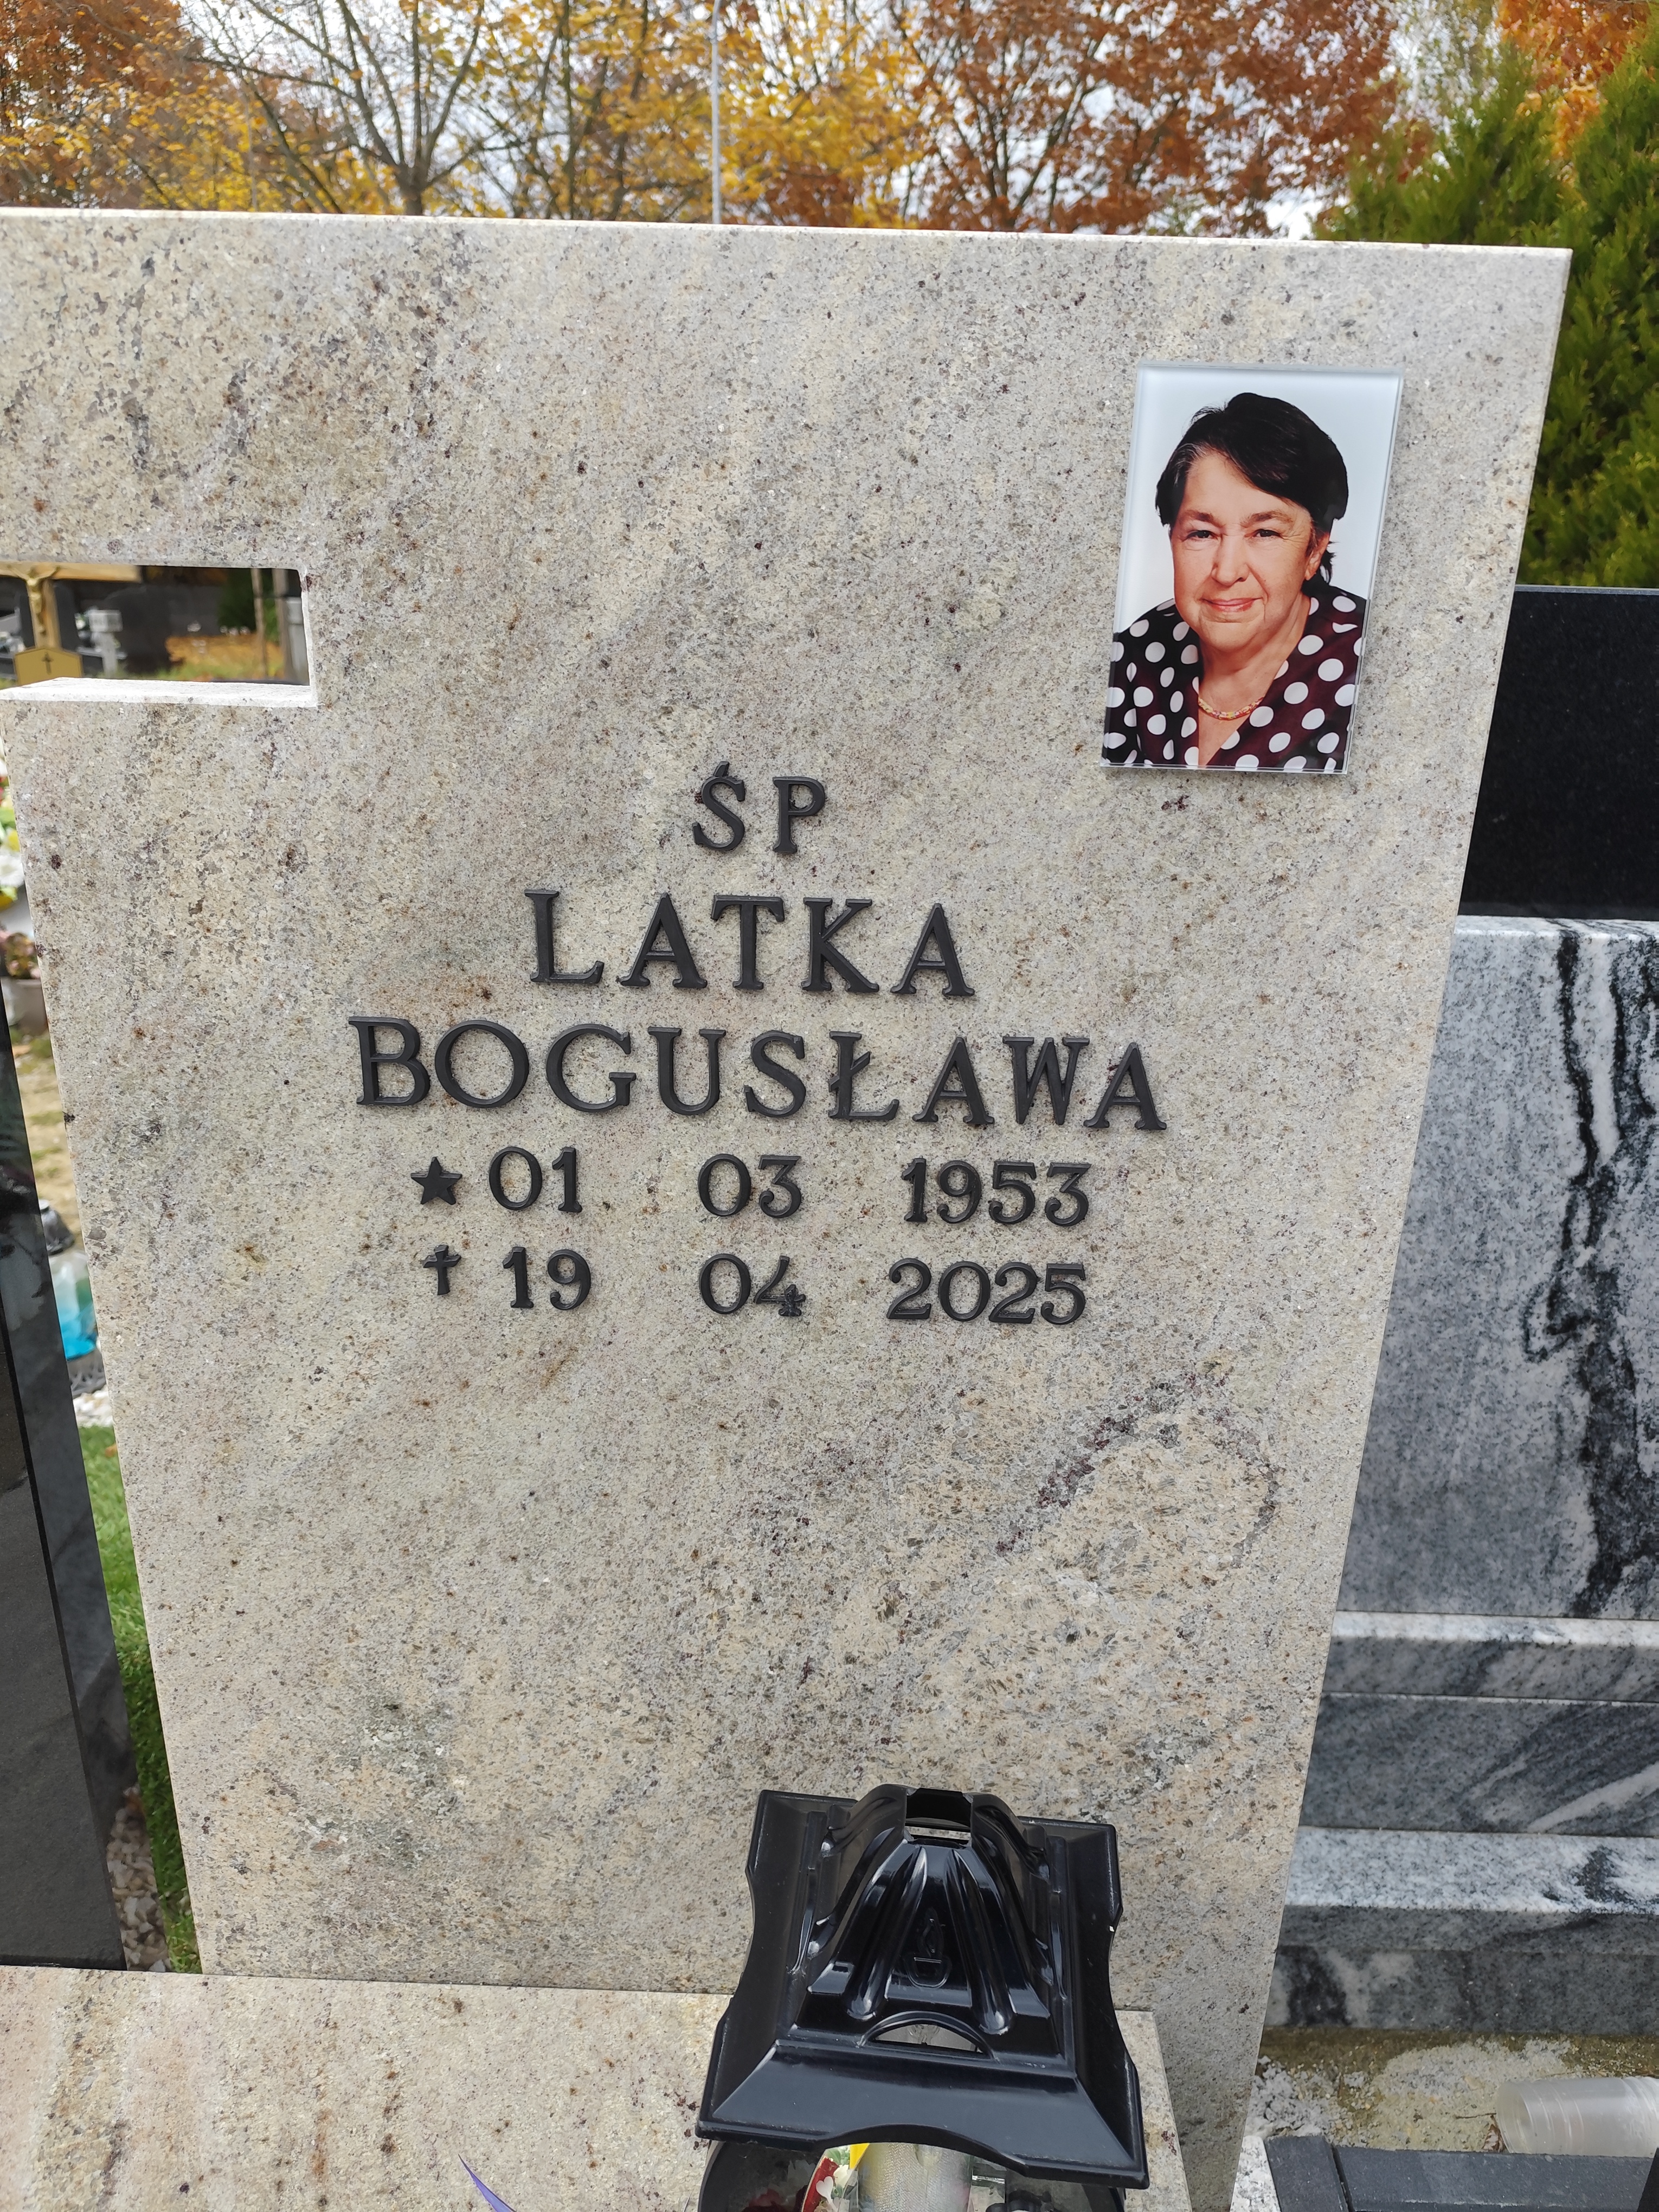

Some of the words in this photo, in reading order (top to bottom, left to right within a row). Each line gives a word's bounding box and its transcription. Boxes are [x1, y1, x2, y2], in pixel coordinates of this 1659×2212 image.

[526, 892, 974, 998] LATKA
[349, 1018, 1167, 1133] BOGUSŁAWA
[488, 1147, 582, 1217] 01
[698, 1154, 804, 1220] 03
[901, 1158, 1091, 1229] 1953
[503, 1246, 591, 1311] 19
[699, 1253, 806, 1318] 04
[886, 1258, 1086, 1326] 2025
